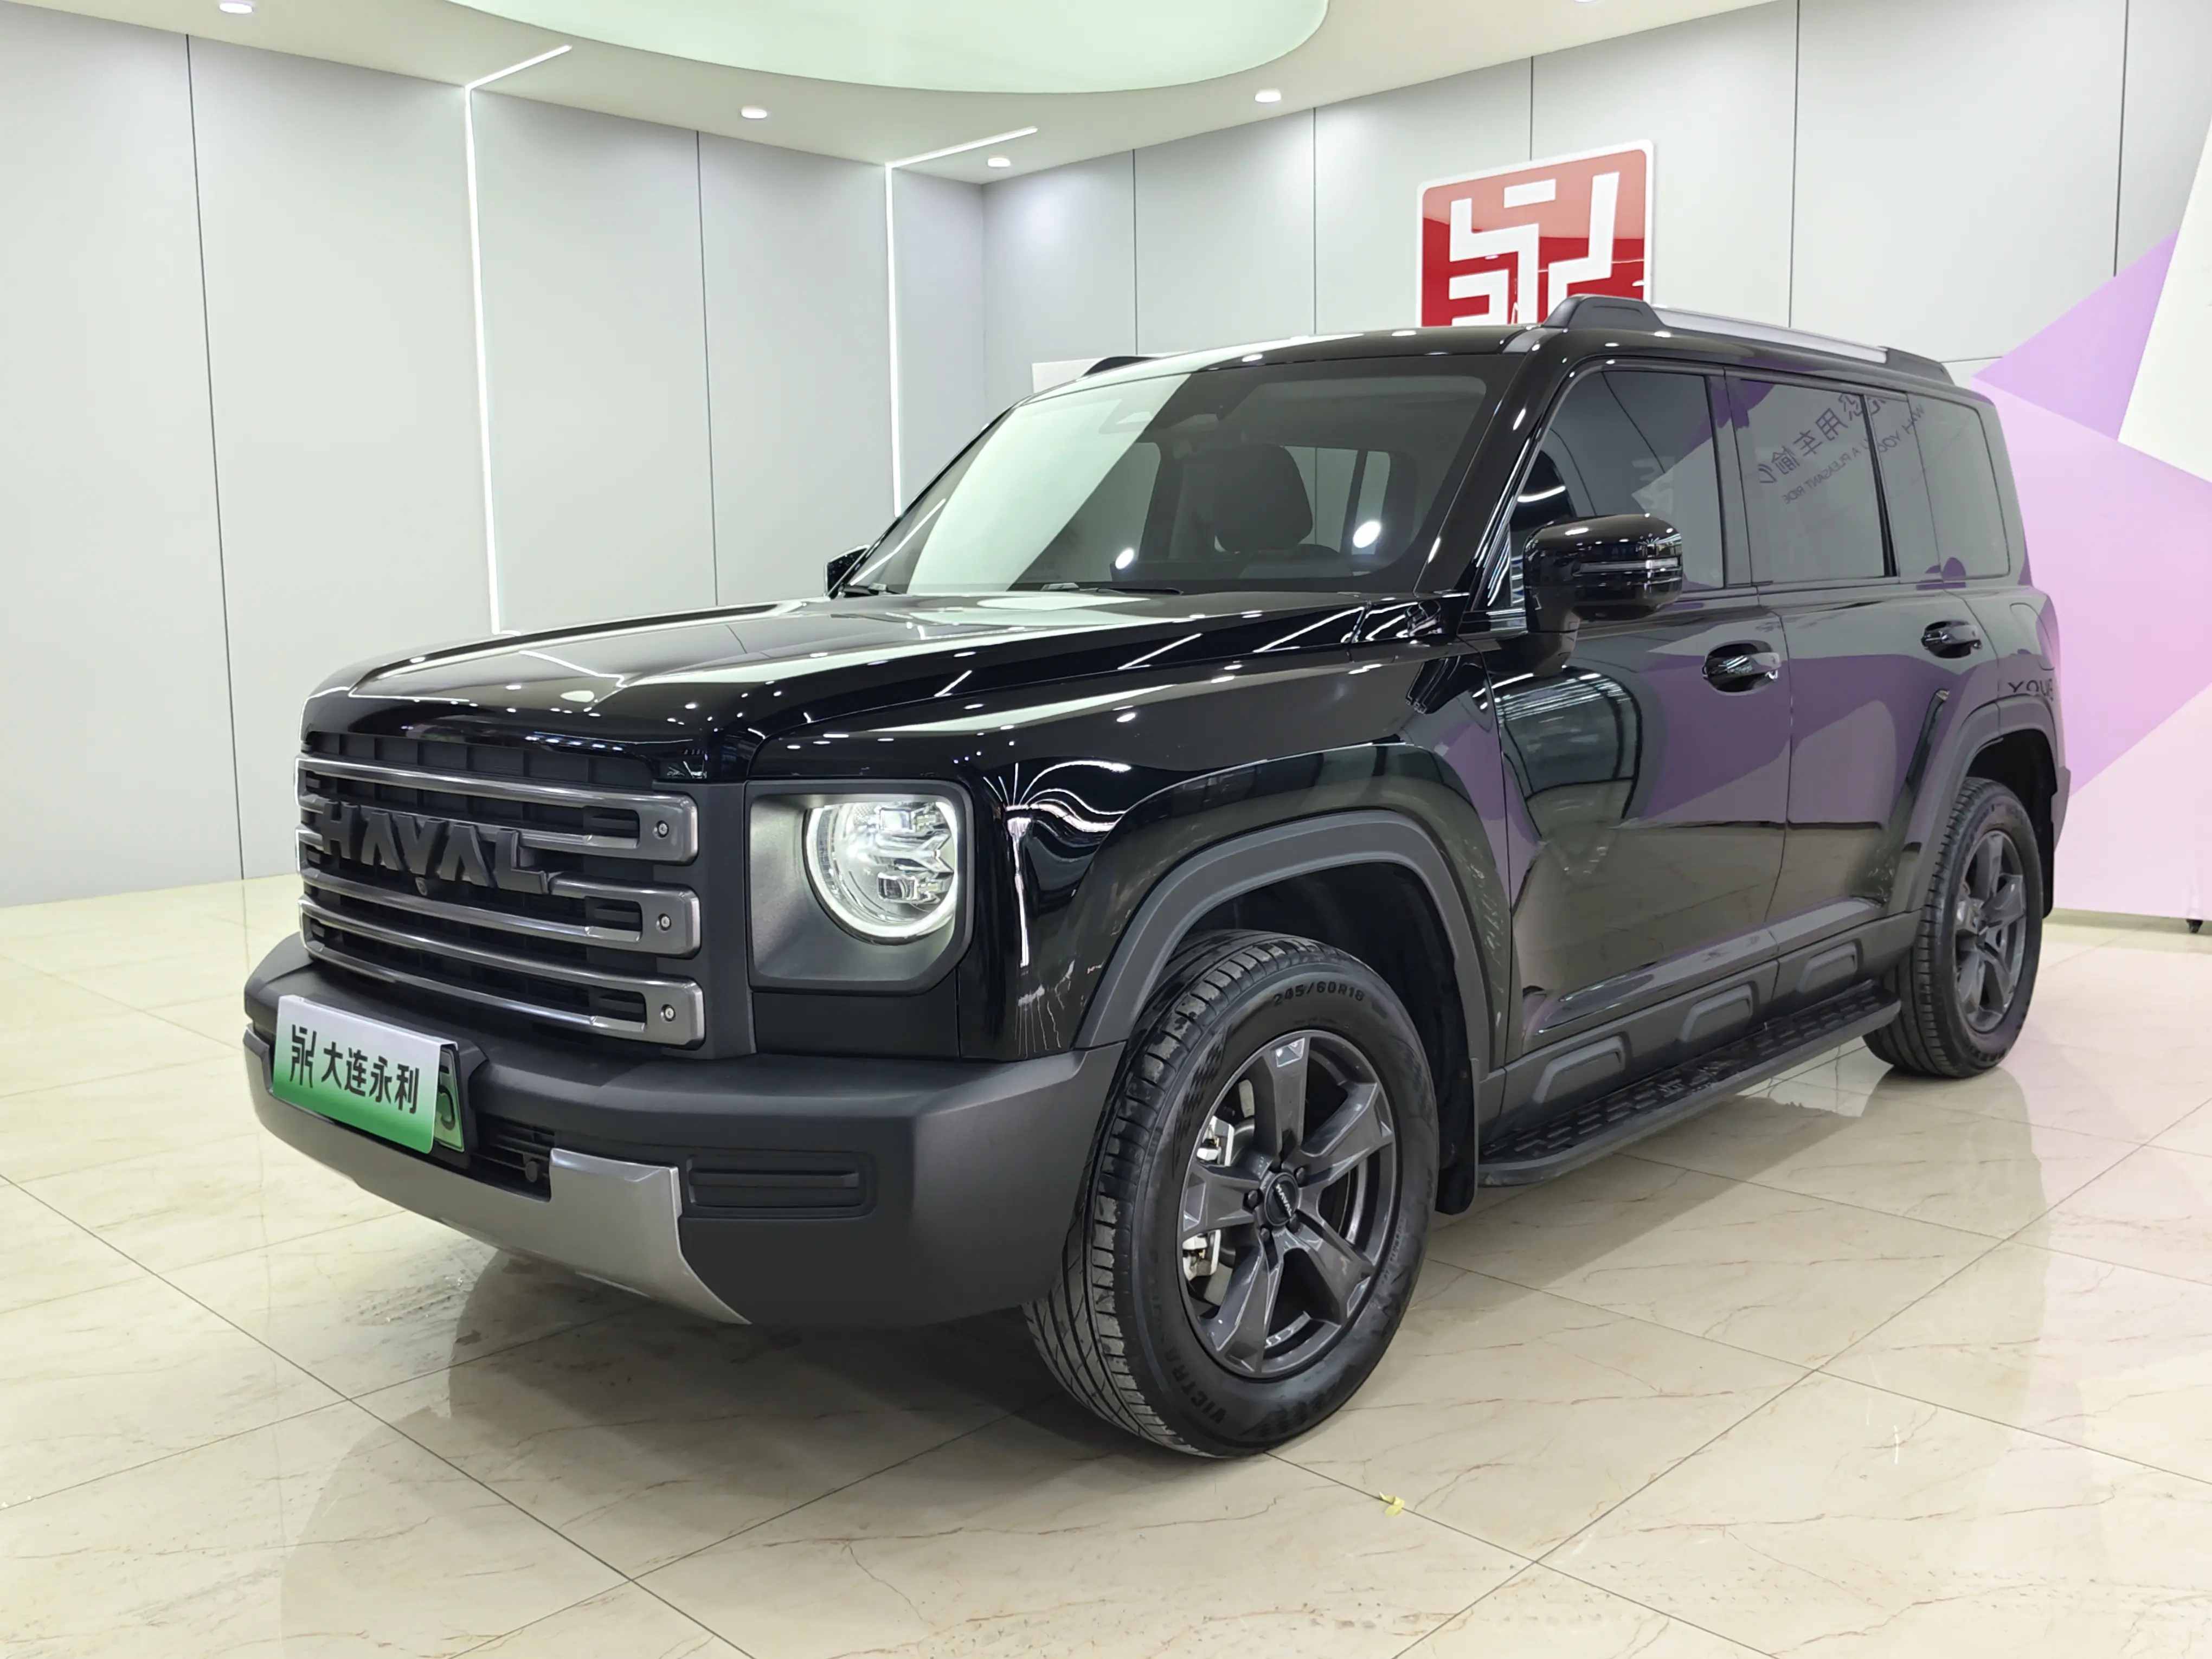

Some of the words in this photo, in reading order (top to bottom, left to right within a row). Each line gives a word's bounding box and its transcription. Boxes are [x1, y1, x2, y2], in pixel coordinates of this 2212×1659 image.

[320, 800, 549, 895] HAVAL
[1272, 981, 1366, 1007] 245/60R18
[320, 1041, 421, 1115] 大连永利
[1275, 1183, 1293, 1218] HAVAL
[1164, 1346, 1228, 1425] VICTRA
